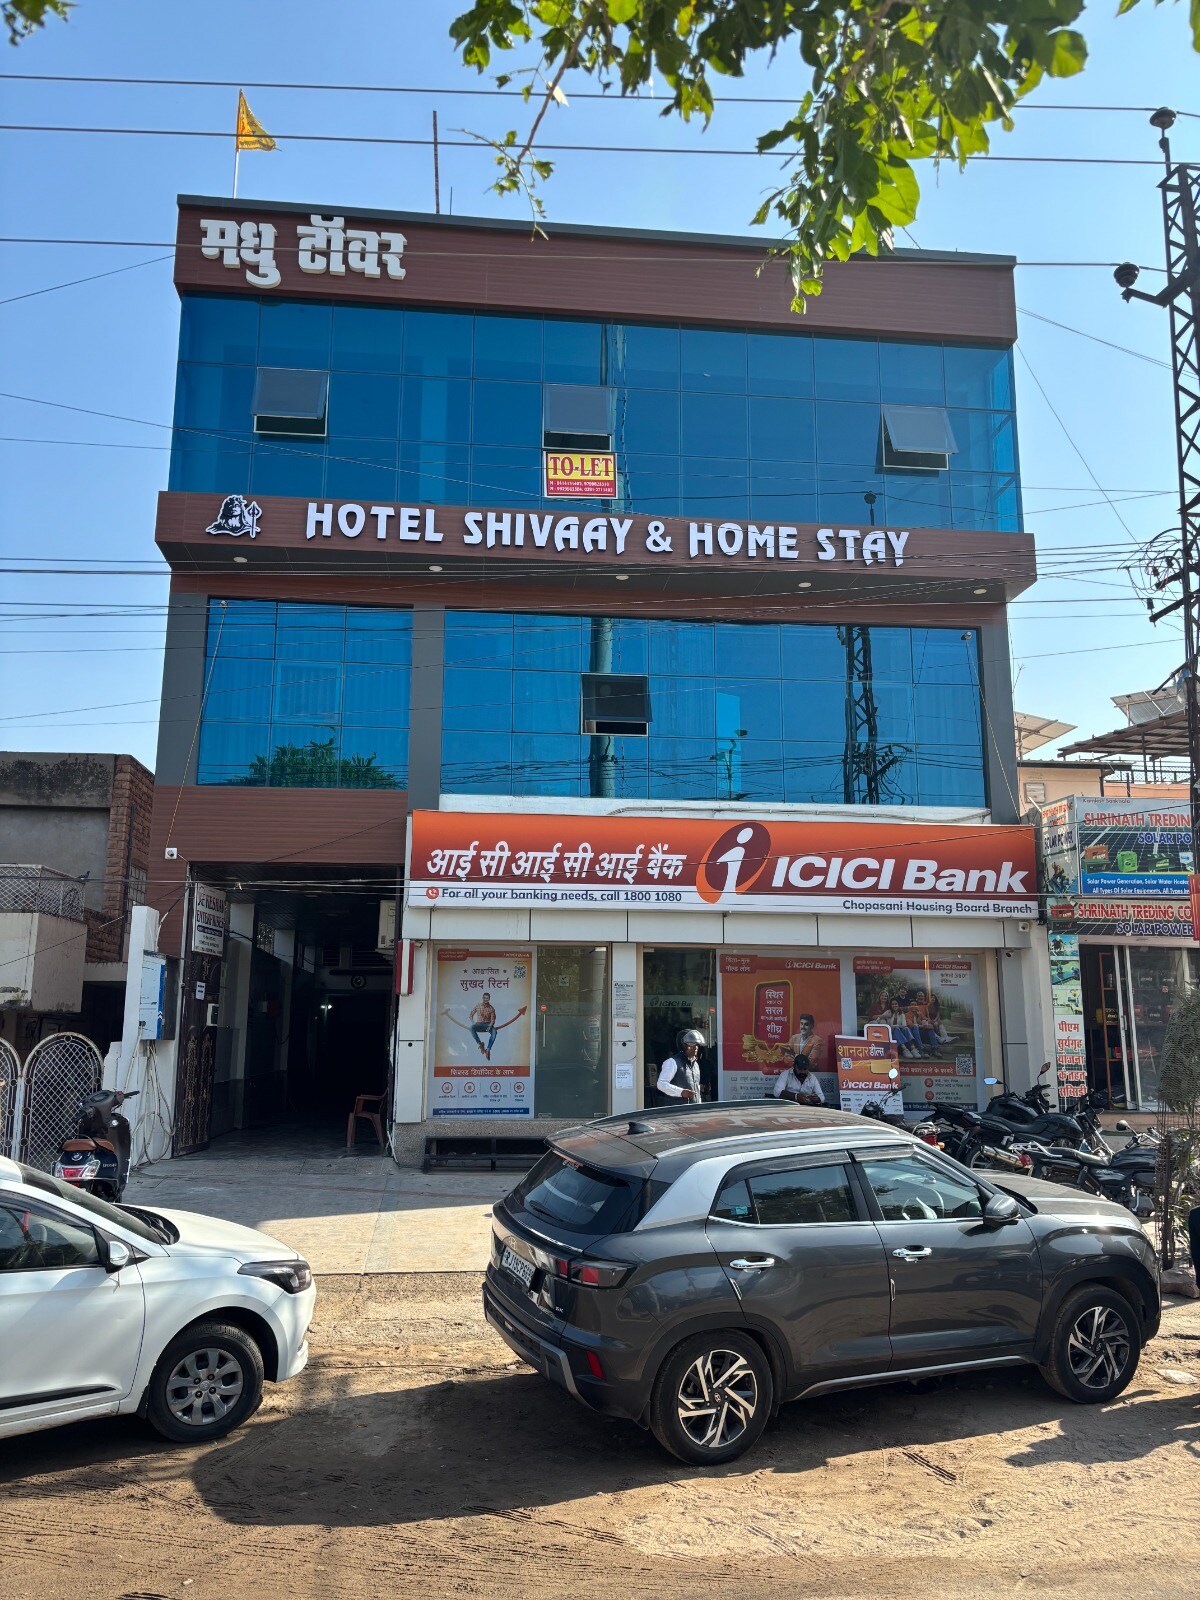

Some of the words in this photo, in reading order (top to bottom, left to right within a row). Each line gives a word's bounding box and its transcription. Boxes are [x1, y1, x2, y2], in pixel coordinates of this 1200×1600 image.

[200, 218, 282, 289] मधु
[297, 214, 407, 280] टॉवर
[550, 457, 612, 477] TO-LET
[306, 502, 444, 542] HOTEL
[463, 512, 634, 556] SHIVAAY
[645, 521, 674, 553] &
[689, 522, 799, 561] HOME
[816, 527, 910, 568] STAY
[1083, 812, 1145, 827] SHRINATH
[1148, 813, 1192, 827] TREDIN
[1138, 832, 1173, 844] SOLAR
[427, 841, 480, 882] आई
[480, 840, 512, 877] सी
[512, 842, 563, 884] आई
[563, 842, 595, 879] सी
[595, 844, 645, 885] आई
[647, 843, 688, 880] बैंक
[771, 856, 897, 890] ICICI
[902, 859, 1030, 893] Bank
[442, 888, 462, 899] For
[464, 888, 479, 899] all
[482, 890, 509, 901] your
[511, 889, 558, 902] banking
[560, 890, 598, 902] needs,
[600, 891, 620, 901] call
[623, 892, 651, 901] 1800
[655, 893, 682, 902] 1080
[842, 900, 903, 912] Chopasani
[907, 901, 953, 914] Housing
[956, 902, 991, 913] Board
[993, 903, 1032, 914] Branch
[1077, 903, 1129, 919] SHRINATH
[1131, 904, 1175, 920] TREDING
[1117, 922, 1152, 935] SOLAR
[1154, 923, 1194, 936] POWER
[460, 979, 484, 991] सुखद
[488, 977, 510, 989] रिटर्न
[765, 989, 784, 999] स्थिर
[765, 1006, 784, 1015] सरल
[766, 1022, 783, 1034] शीघ्र
[1058, 1020, 1080, 1032] पीएम
[838, 1045, 869, 1058] शानदार
[869, 1043, 884, 1057] डील्स
[1068, 1071, 1086, 1081] तहत
[874, 1082, 899, 1090] Bank
